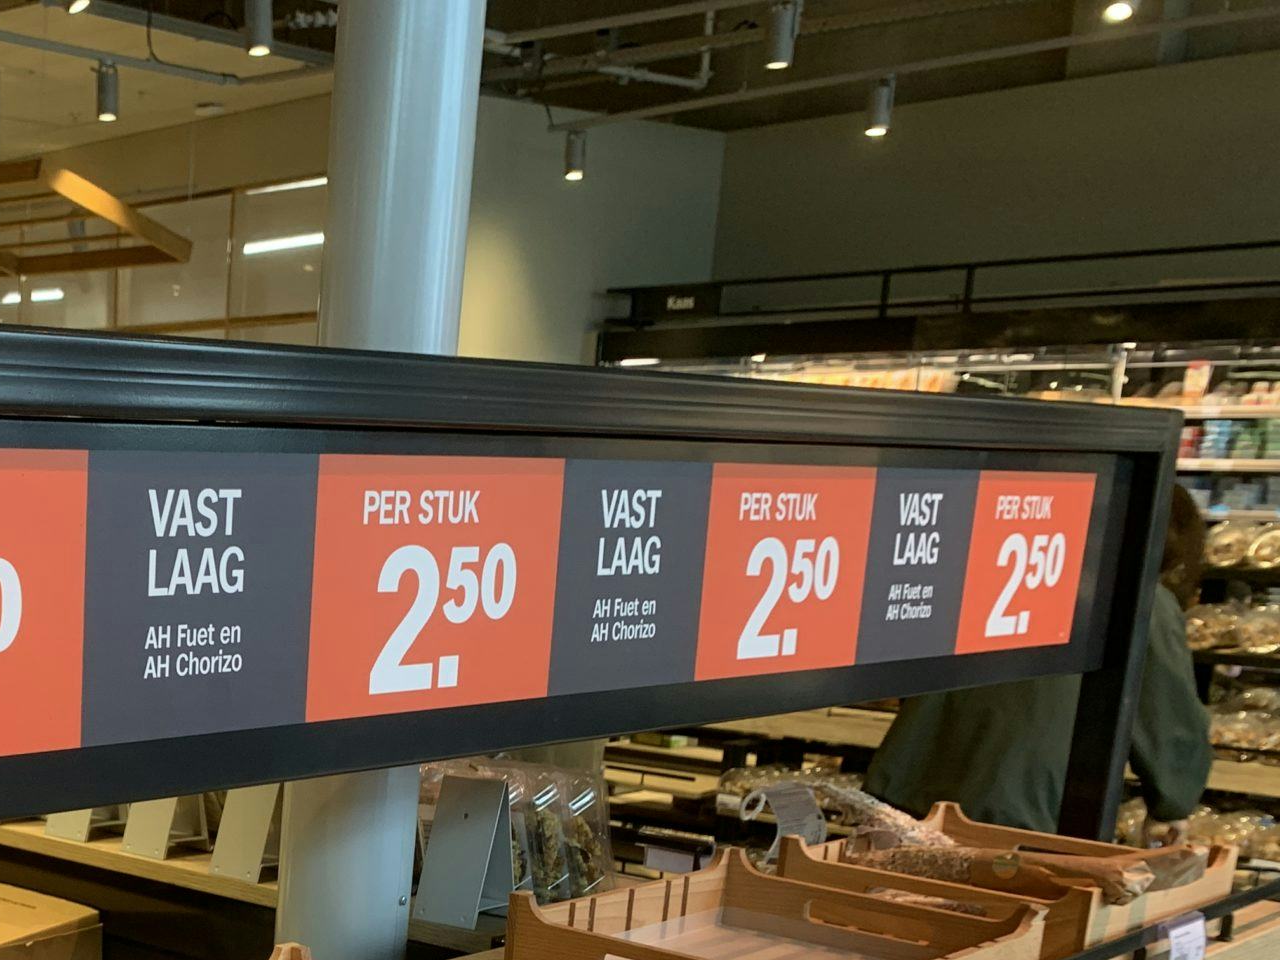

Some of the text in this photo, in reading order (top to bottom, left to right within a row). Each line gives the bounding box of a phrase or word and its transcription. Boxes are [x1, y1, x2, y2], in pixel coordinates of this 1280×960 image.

[149, 489, 242, 538] VAST
[363, 489, 480, 526] PER STUK
[600, 490, 662, 529] VAST
[739, 492, 818, 522] PER STUK
[898, 493, 944, 527] VAST
[995, 495, 1053, 521] PER STUK
[596, 536, 661, 577] LAAG
[893, 531, 940, 566] LAAG
[148, 547, 245, 597] LAAG
[888, 583, 933, 601] AH Fuet en
[369, 543, 517, 696] 2.50
[592, 598, 656, 619] AH Fuet en
[886, 601, 932, 621] AH Chorizo
[144, 624, 242, 649] AH Fuet en
[591, 619, 656, 642] AH Chorizo
[144, 650, 242, 678] AH Chorizo
